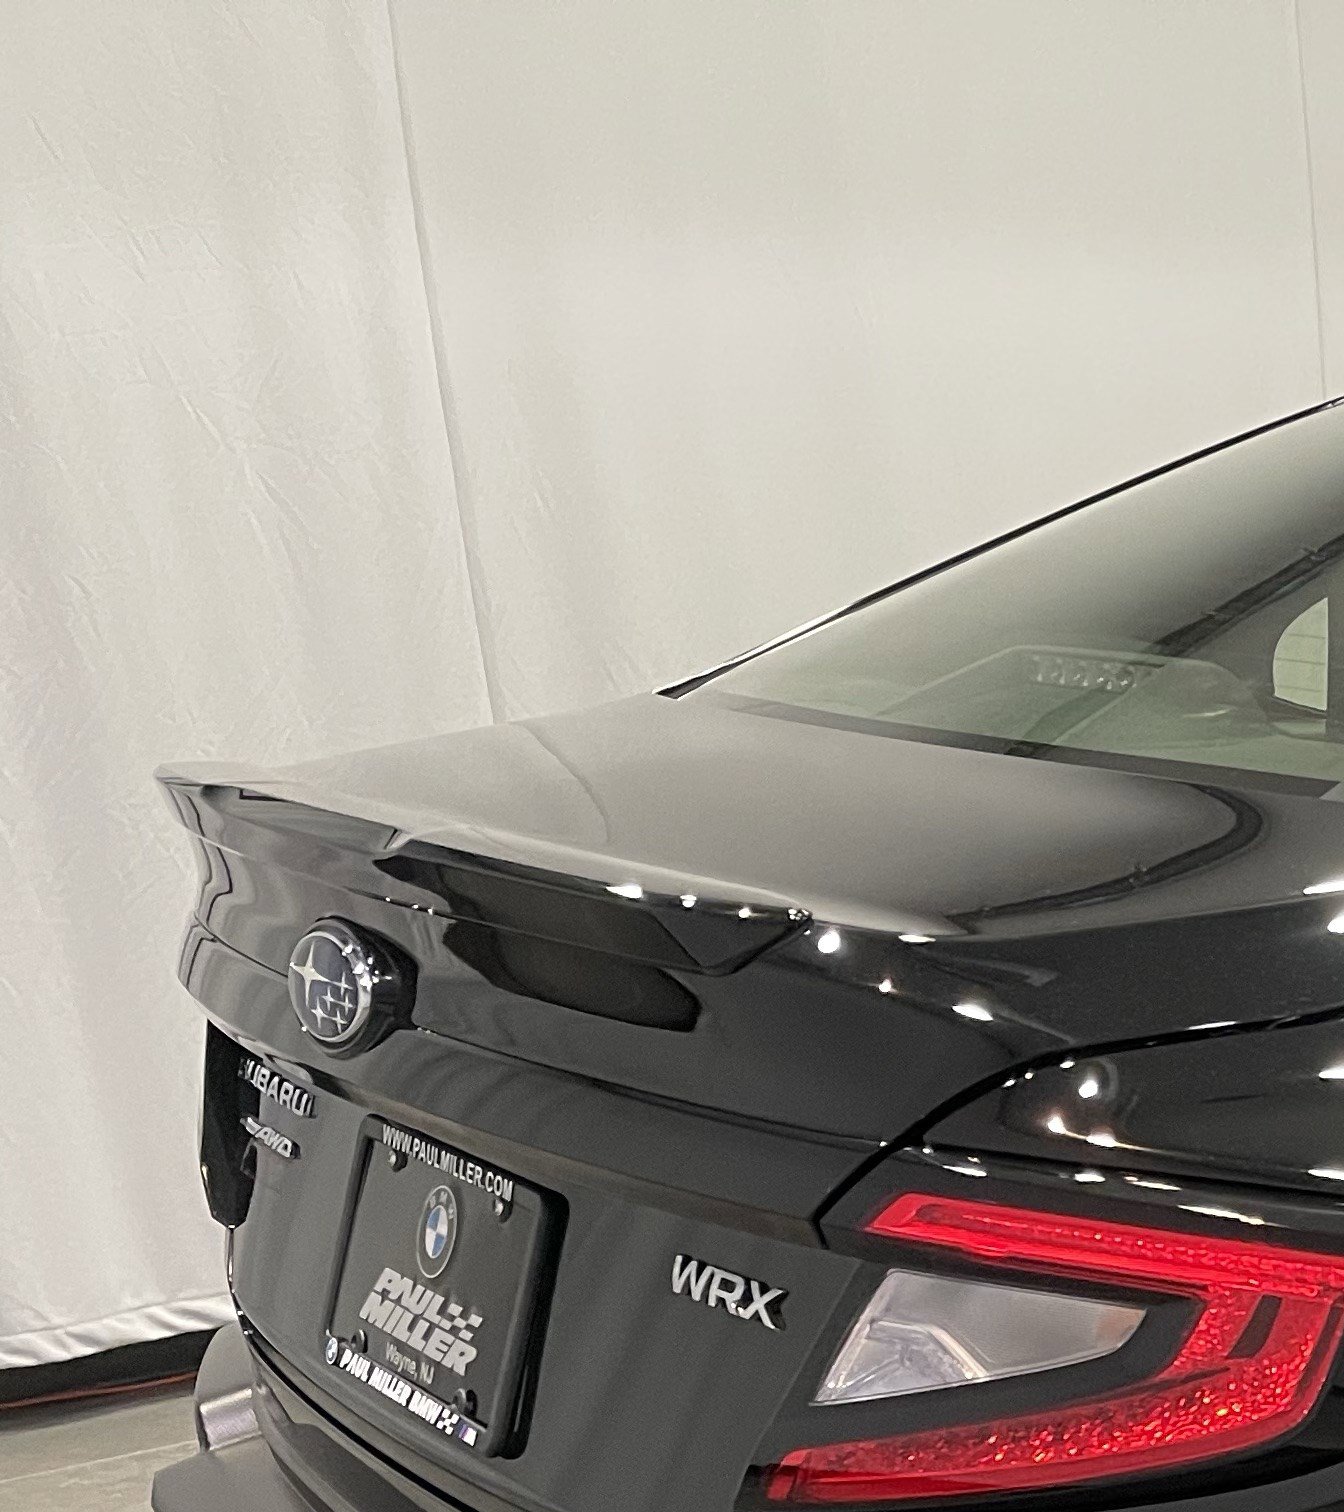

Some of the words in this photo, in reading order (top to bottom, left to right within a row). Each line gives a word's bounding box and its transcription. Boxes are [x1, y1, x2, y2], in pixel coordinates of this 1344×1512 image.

[238, 1058, 312, 1117] SUBARU
[382, 1123, 514, 1202] WWW.PAULMILLER.COM
[373, 1267, 446, 1325] PAUL
[671, 1254, 785, 1330] WRX
[359, 1291, 478, 1377] MILLER
[385, 1341, 418, 1380] Wayne,
[420, 1361, 435, 1385] NJ
[339, 1348, 371, 1382] PAUL
[368, 1366, 412, 1407] MILLER
[408, 1390, 443, 1425] BMW
